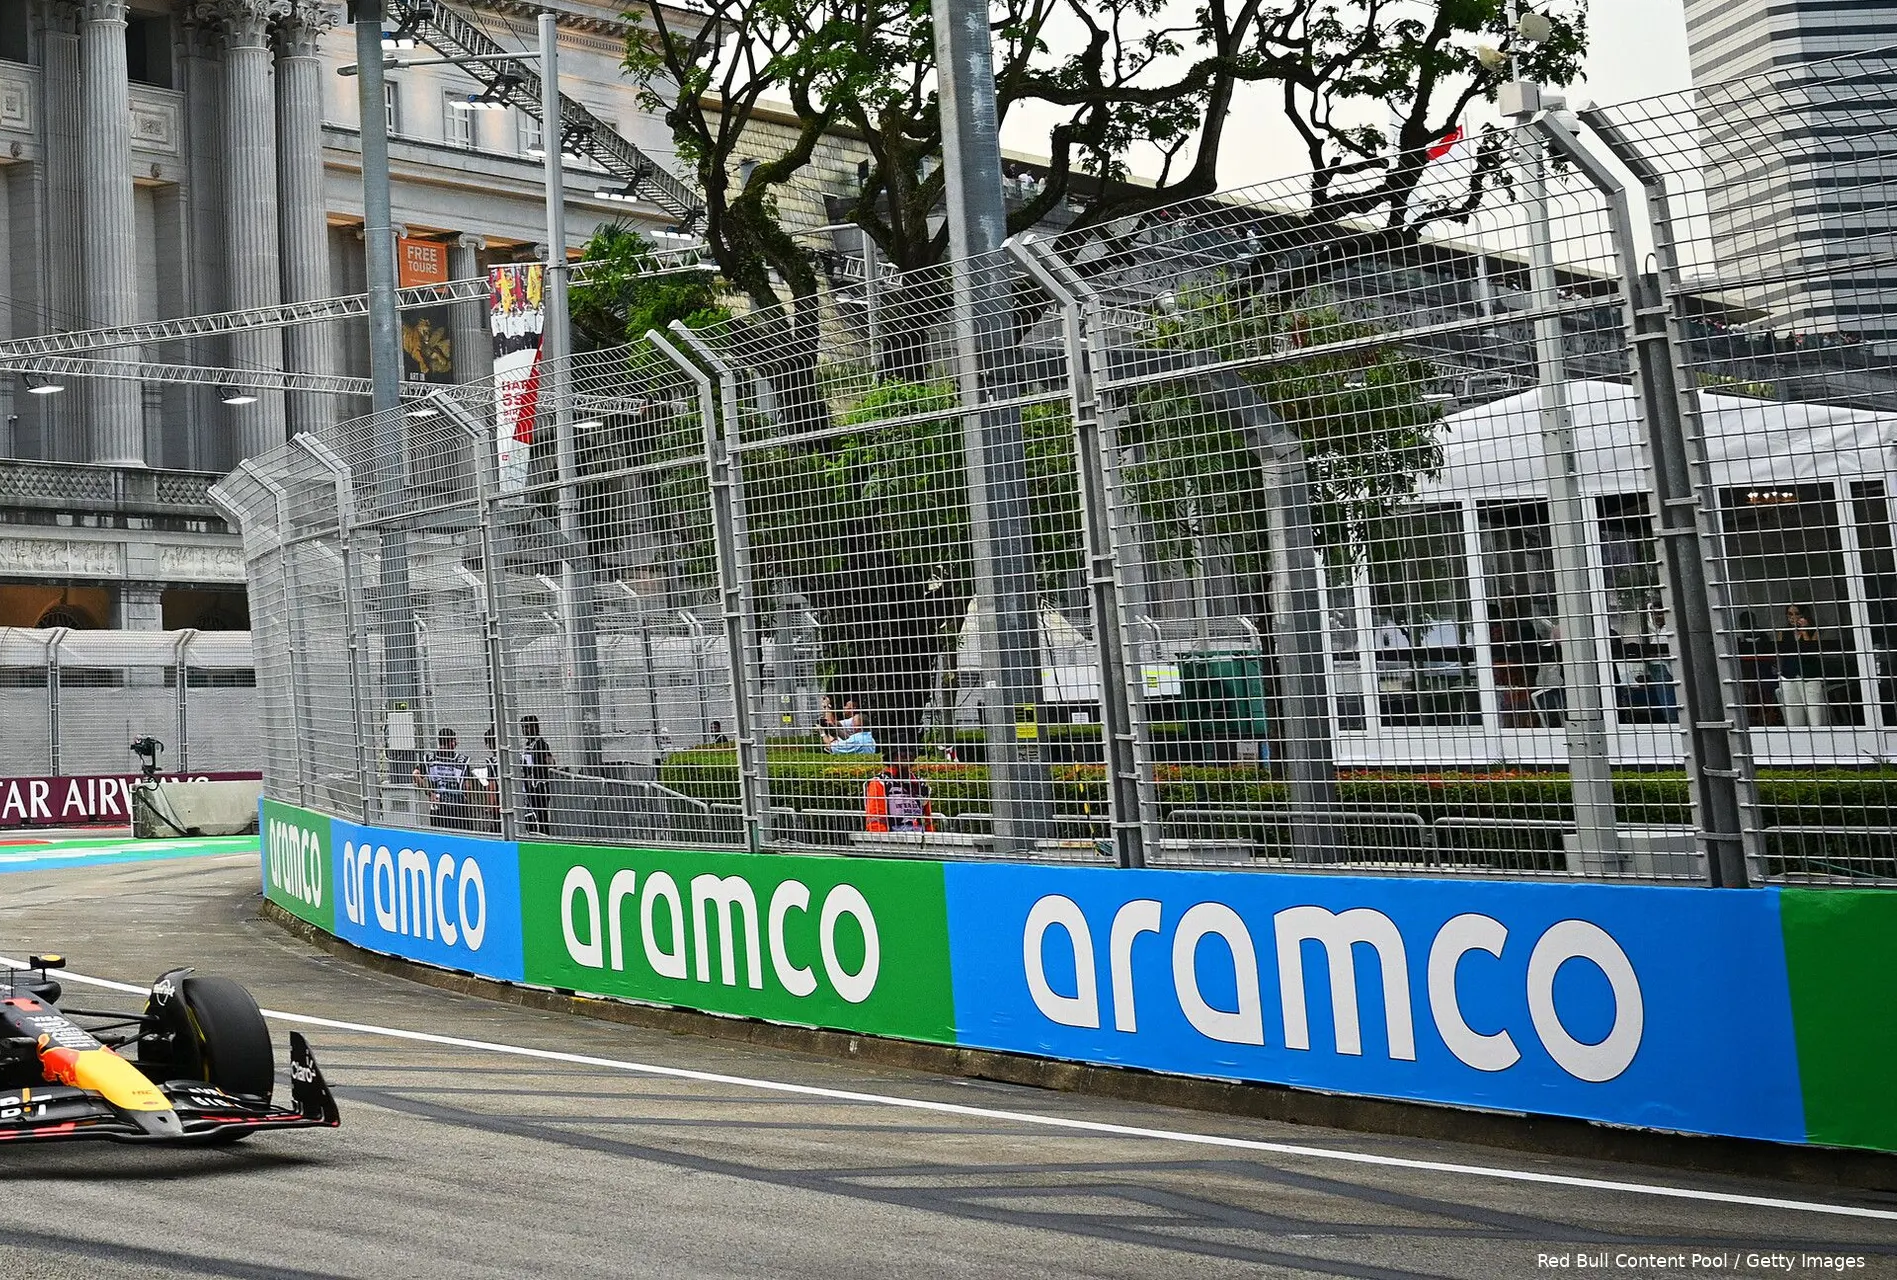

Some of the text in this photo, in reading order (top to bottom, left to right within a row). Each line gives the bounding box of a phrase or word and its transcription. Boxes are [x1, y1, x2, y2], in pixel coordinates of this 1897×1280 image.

[407, 245, 438, 262] FREE
[407, 260, 438, 275] TOURS
[269, 817, 322, 909] aramco
[343, 841, 486, 951] aramco
[561, 865, 880, 1003] aramco
[1023, 894, 1644, 1083] aramco
[291, 1060, 314, 1083] Claro
